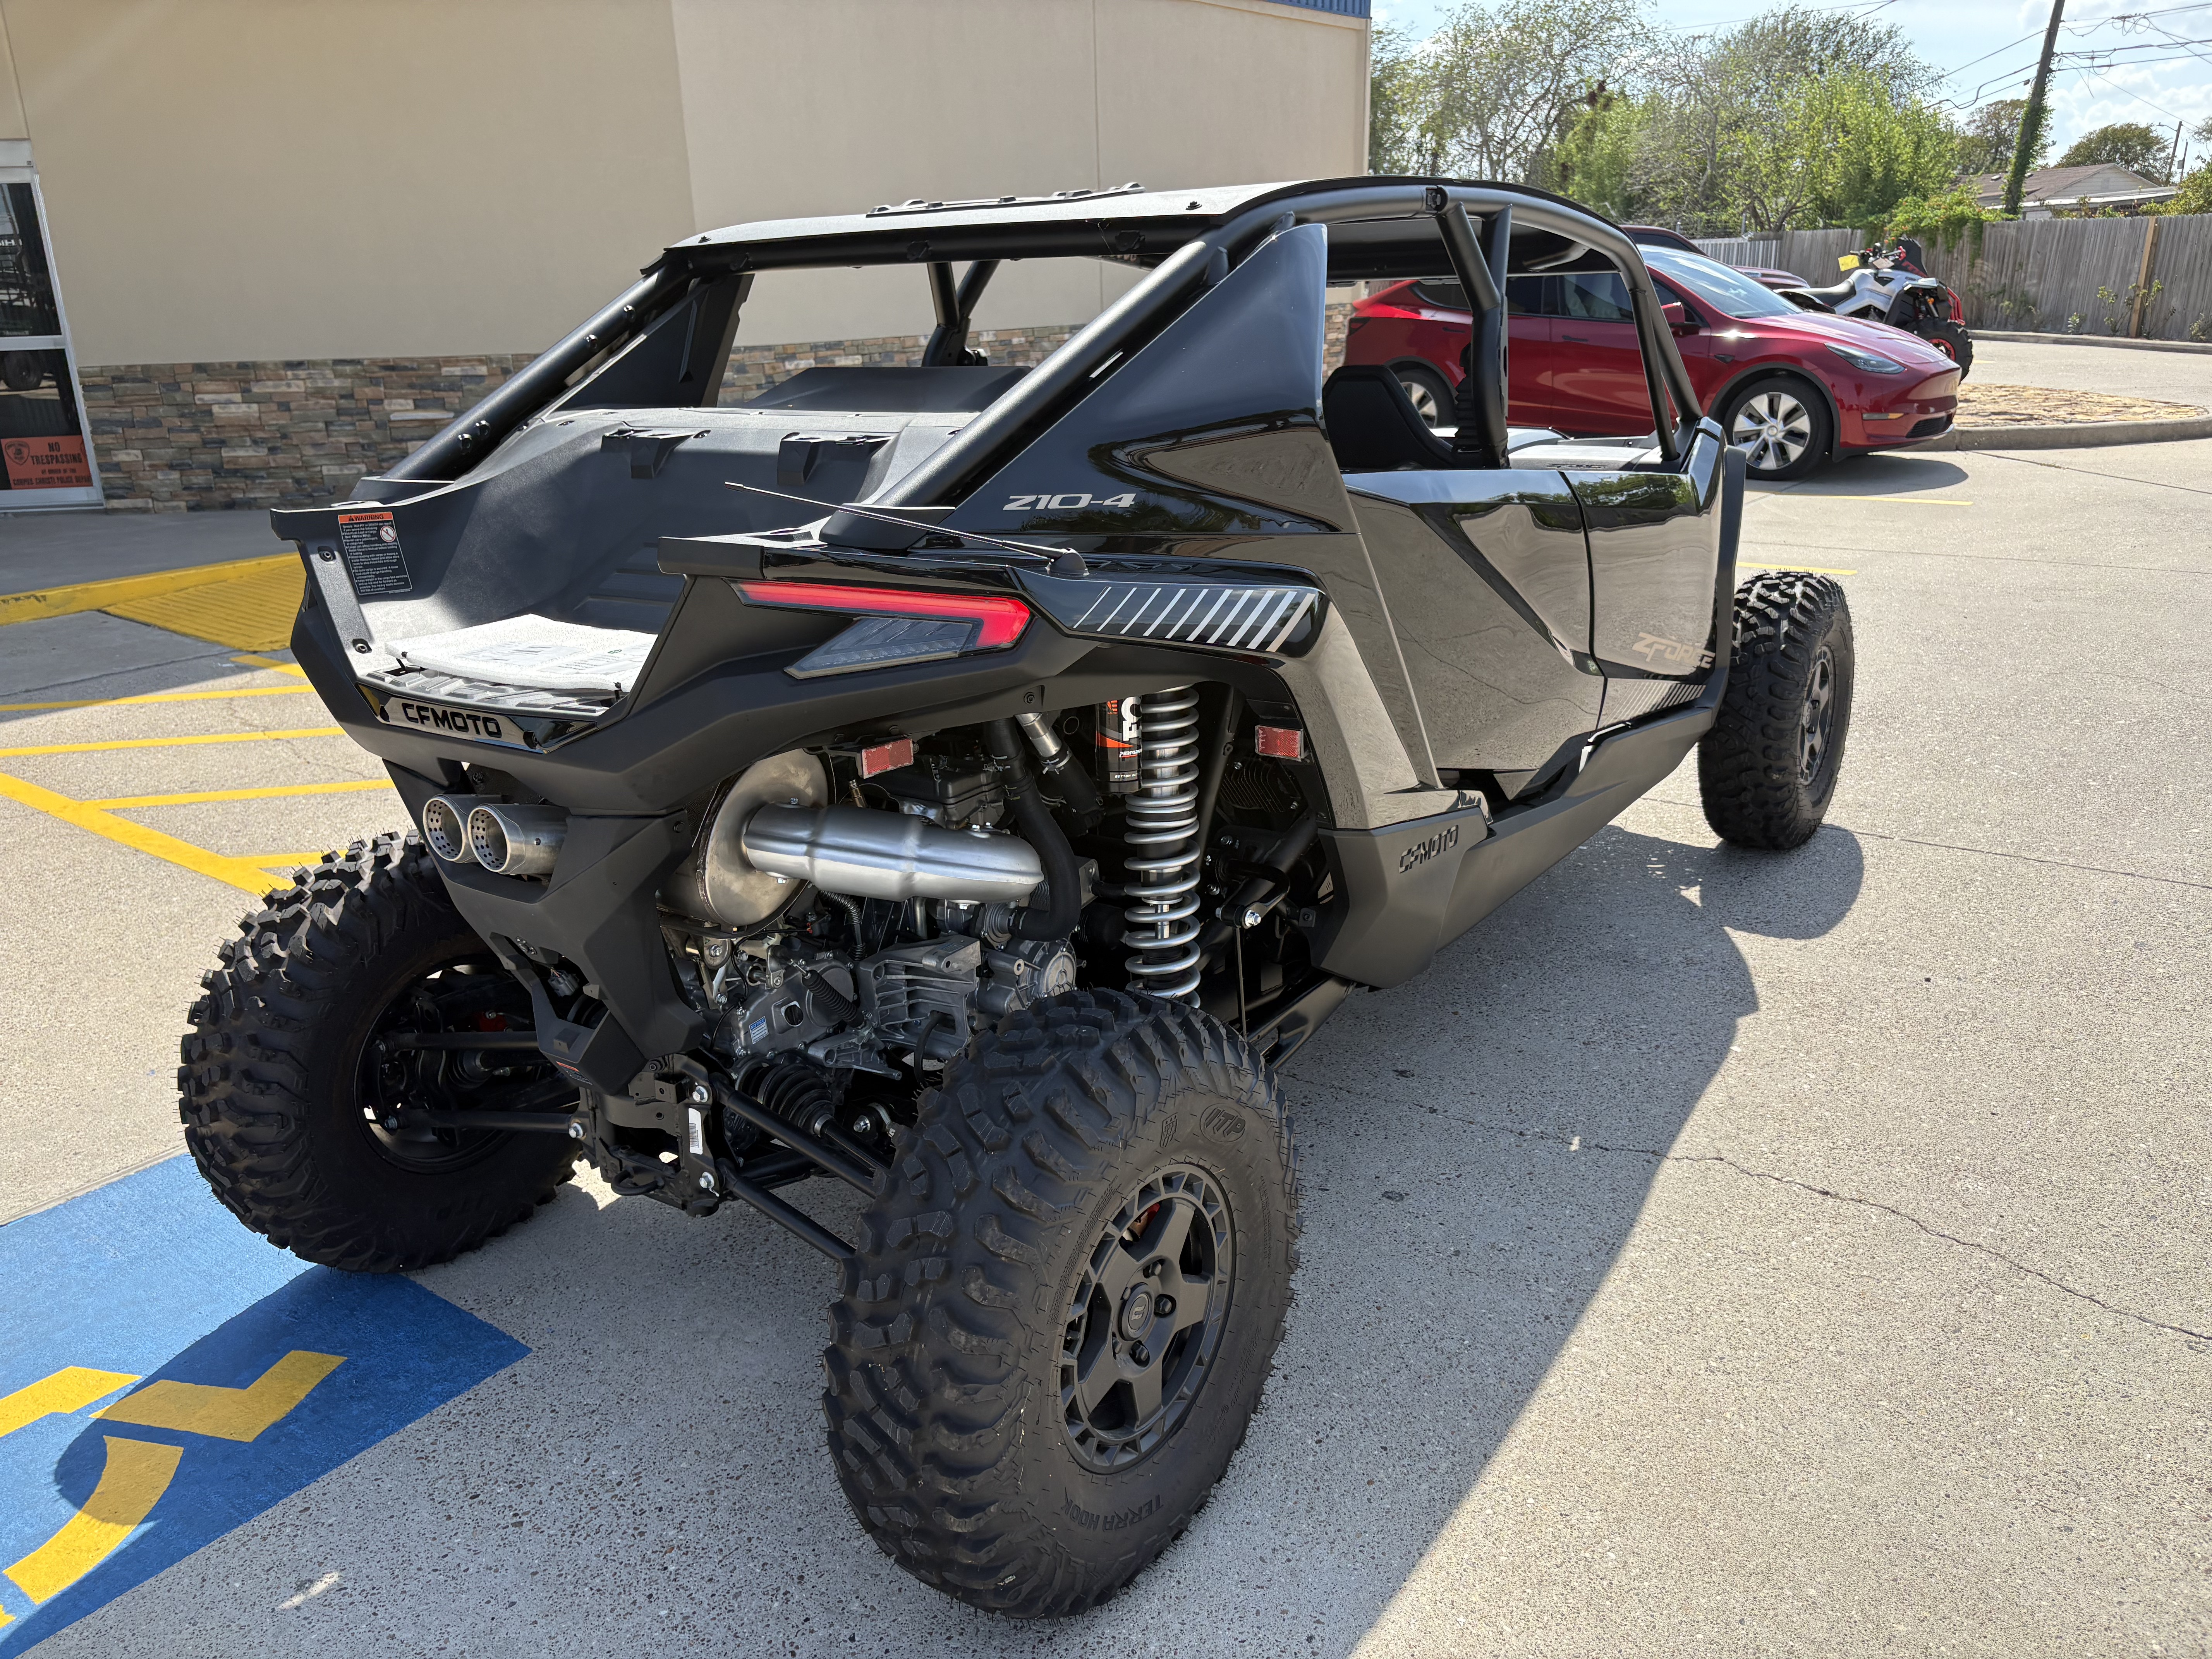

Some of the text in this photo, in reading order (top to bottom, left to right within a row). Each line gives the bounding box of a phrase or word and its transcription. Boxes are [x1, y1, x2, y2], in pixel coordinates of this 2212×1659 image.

[31, 453, 82, 465] TRESPASSING
[48, 442, 60, 452] NO
[1003, 493, 1137, 511] Z10-4
[401, 702, 502, 738] CFMOTO
[1399, 824, 1459, 874] CFMOTO
[750, 1018, 766, 1030] NOTICE
[1204, 1108, 1246, 1138] ITP
[1061, 1487, 1164, 1532] TERRA HOOK
